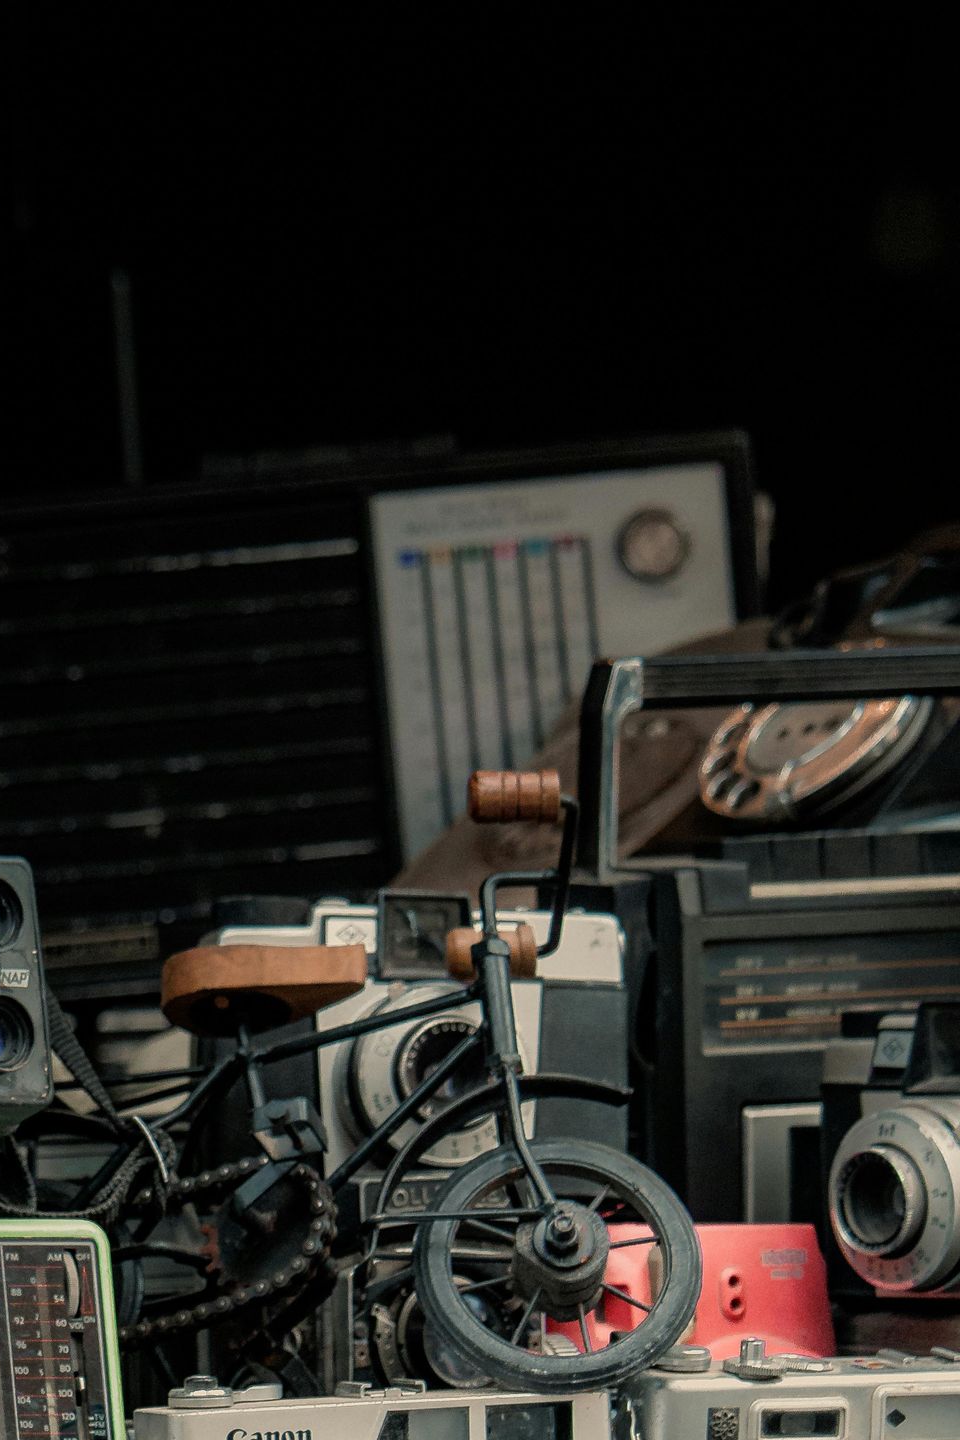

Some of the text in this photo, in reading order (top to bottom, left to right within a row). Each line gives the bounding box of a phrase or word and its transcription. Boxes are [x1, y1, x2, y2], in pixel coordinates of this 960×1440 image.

[5, 1253, 19, 1261] FM
[14, 1317, 24, 1325] 92
[59, 1345, 69, 1353] 70
[14, 1367, 29, 1375] 100
[60, 1365, 71, 1373] 80
[58, 1389, 73, 1397] 100
[17, 1396, 31, 1404] 104
[20, 1420, 33, 1428] 106
